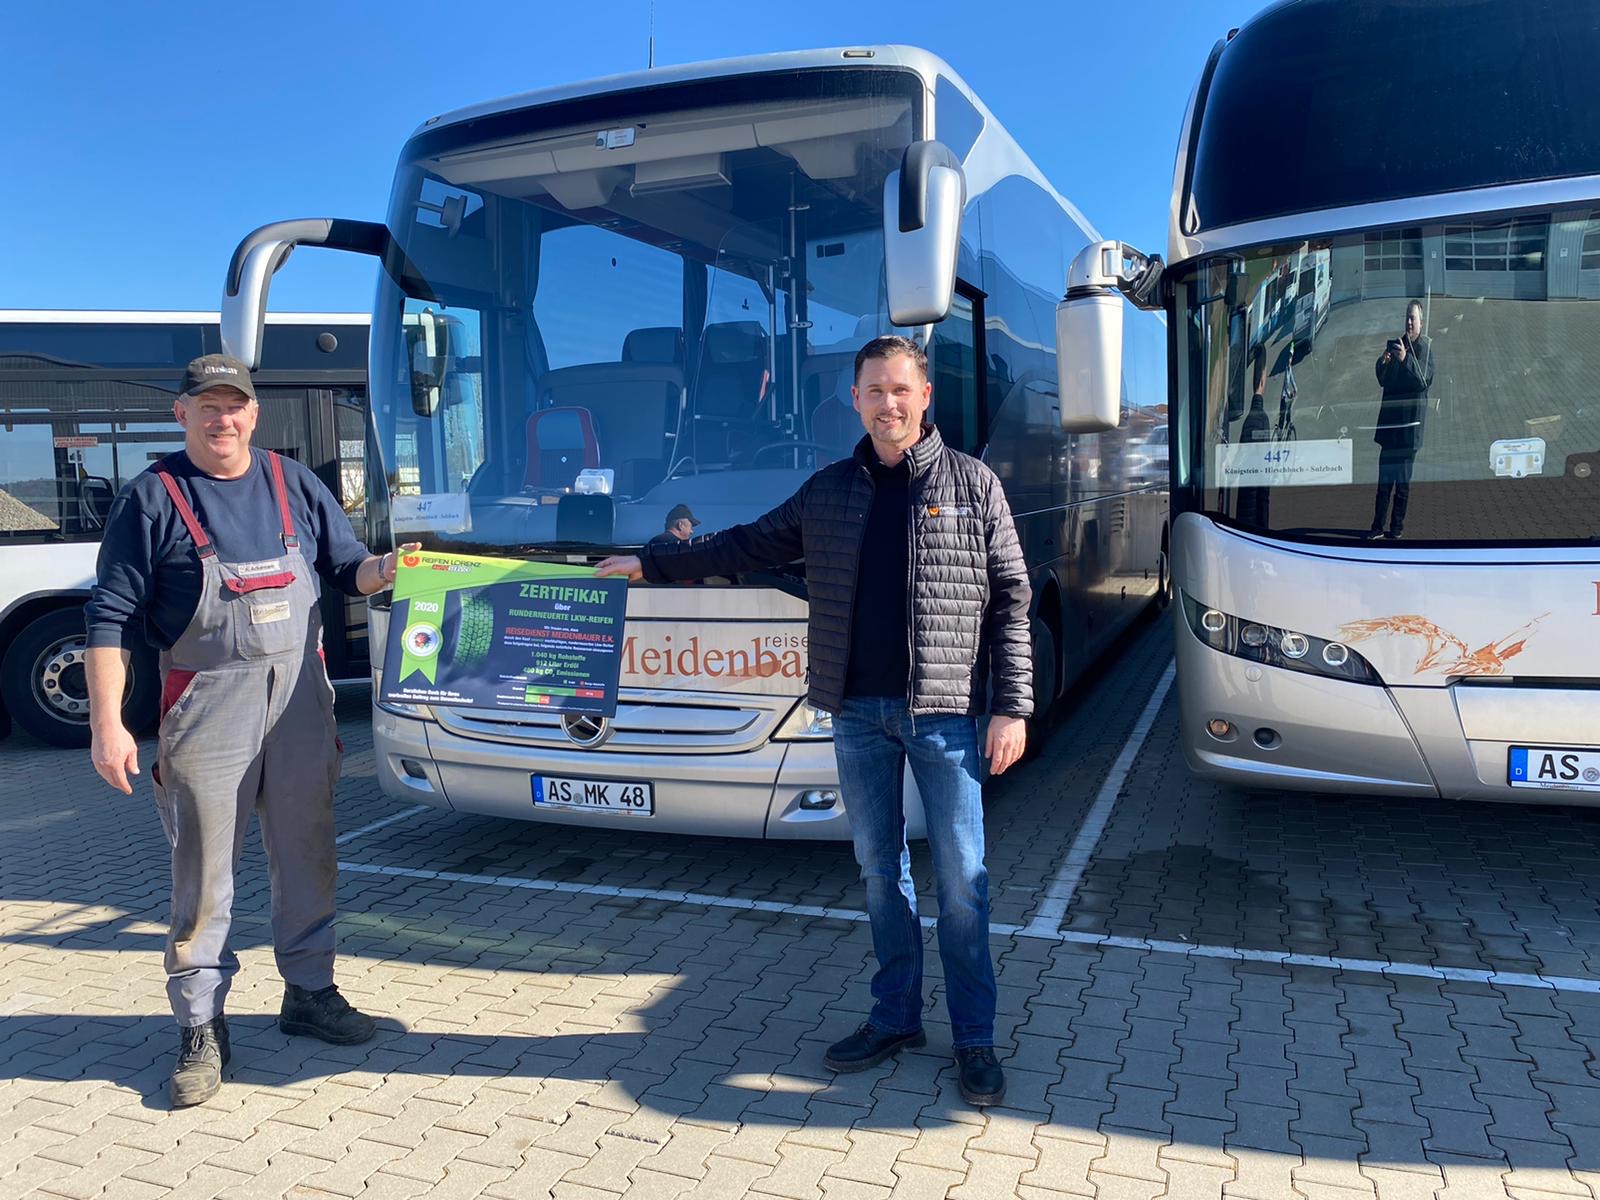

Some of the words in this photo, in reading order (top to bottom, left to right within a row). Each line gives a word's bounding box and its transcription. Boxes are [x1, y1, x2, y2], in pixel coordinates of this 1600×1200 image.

[1264, 450, 1291, 463] 447
[1225, 467, 1259, 476] Königstein
[1265, 466, 1304, 474] Hirschbach
[1310, 465, 1343, 473] Sulzbach
[417, 501, 432, 512] 447
[422, 557, 449, 565] REIFEN
[450, 559, 481, 567] LORENZ
[520, 583, 608, 604] ZERTIFIKAT
[414, 601, 439, 613] 2020
[554, 603, 571, 611] über
[509, 608, 569, 621] RUNDERNEUERTE
[571, 614, 614, 625] LKW-REIFEN
[505, 627, 549, 637] REISEDIENST
[552, 630, 600, 642] MEIDENBAUER
[549, 652, 557, 660] kg
[621, 636, 807, 678] Meidenba
[536, 667, 544, 675] kg
[1515, 767, 1523, 776] D
[1538, 754, 1579, 780] AS
[548, 781, 572, 802] AS
[584, 783, 610, 805] MK
[620, 786, 645, 808] 48
